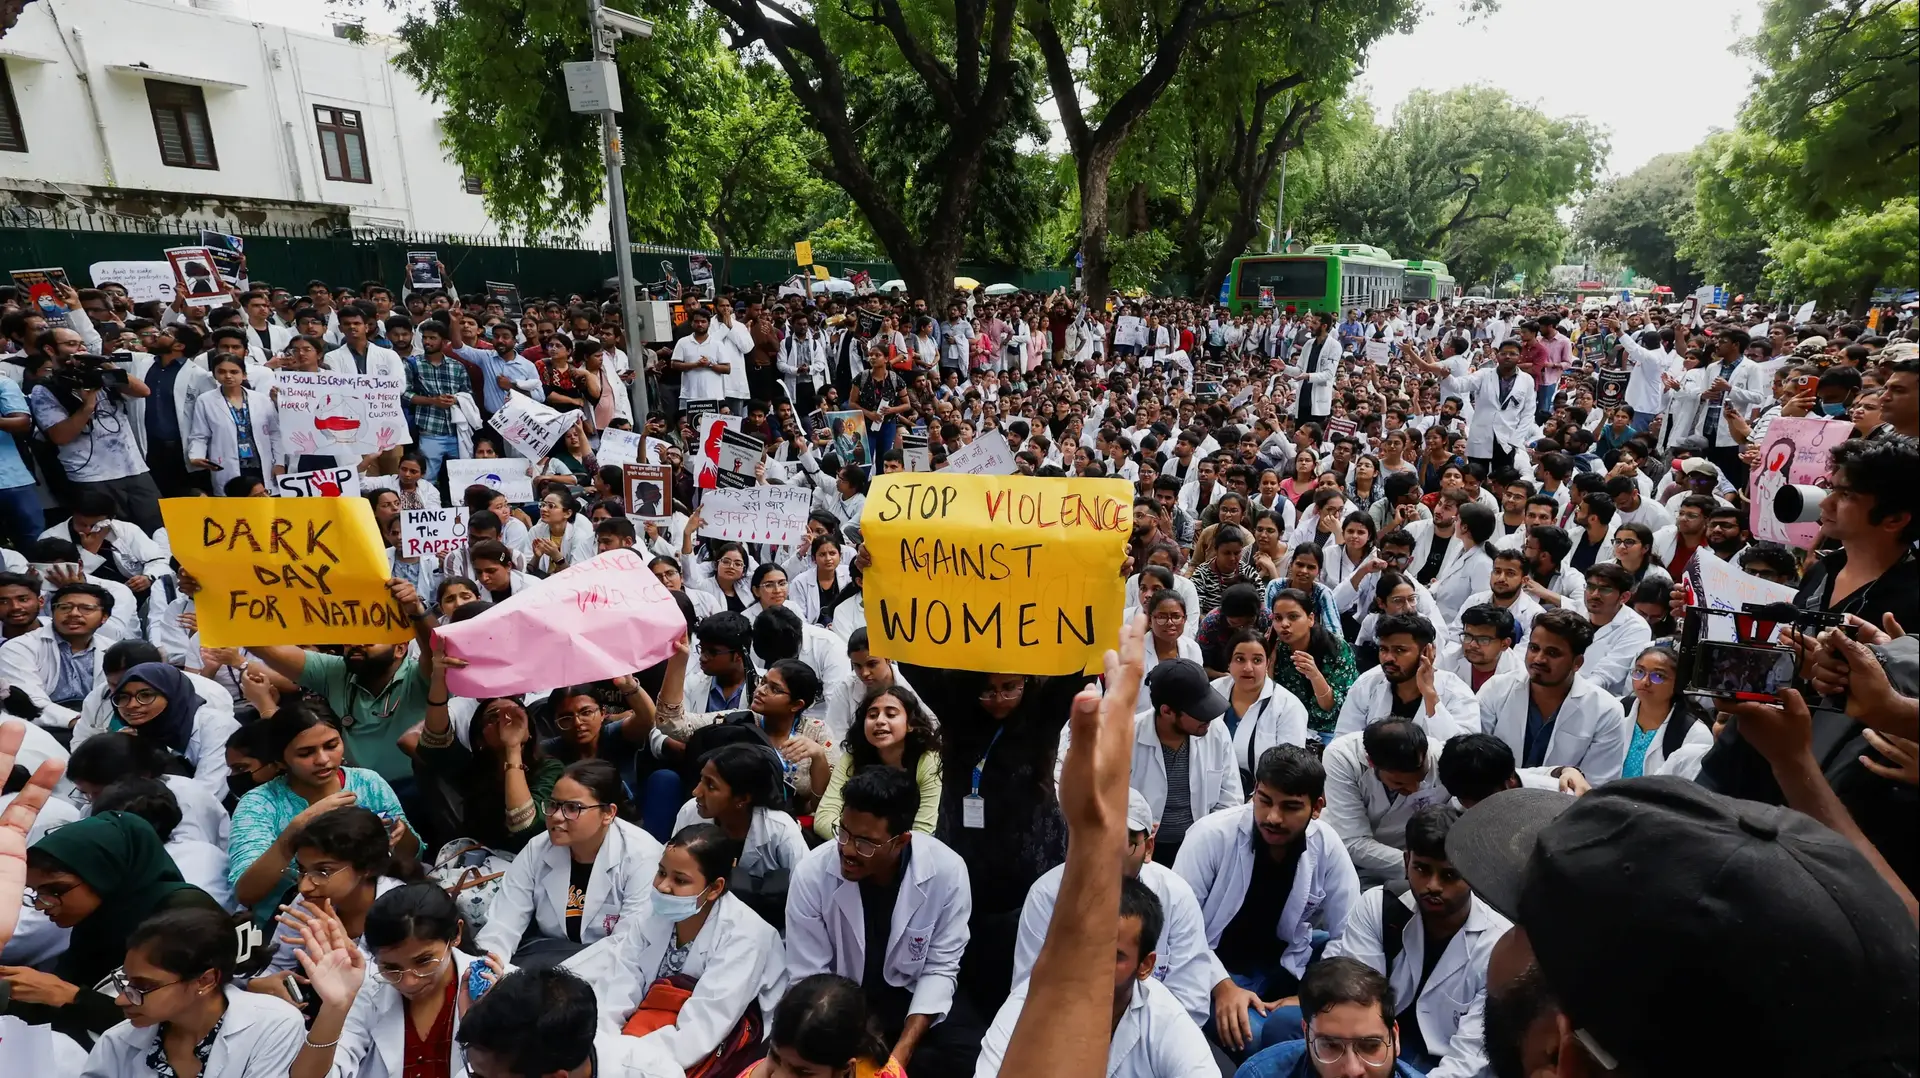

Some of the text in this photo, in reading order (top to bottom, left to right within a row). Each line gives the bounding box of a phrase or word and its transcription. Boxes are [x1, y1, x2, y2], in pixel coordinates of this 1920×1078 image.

[288, 387, 316, 399] BENGAL
[292, 374, 315, 385] SOUL
[316, 374, 327, 385] IS
[328, 376, 356, 389] CRYING
[357, 376, 374, 389] FOR
[373, 377, 399, 389] JUSTICE
[281, 402, 311, 413] HORROR
[408, 511, 447, 524] HANG
[878, 483, 1129, 533] STOP VIOLENCE
[203, 516, 340, 564] DARK
[416, 526, 439, 538] The
[408, 537, 468, 555] RAPIST
[900, 537, 1042, 580] AGAINST
[253, 563, 331, 595] DAY
[561, 554, 640, 580] SILENCE
[229, 590, 411, 631] FOR NATION
[880, 597, 1095, 649] WOMEN
